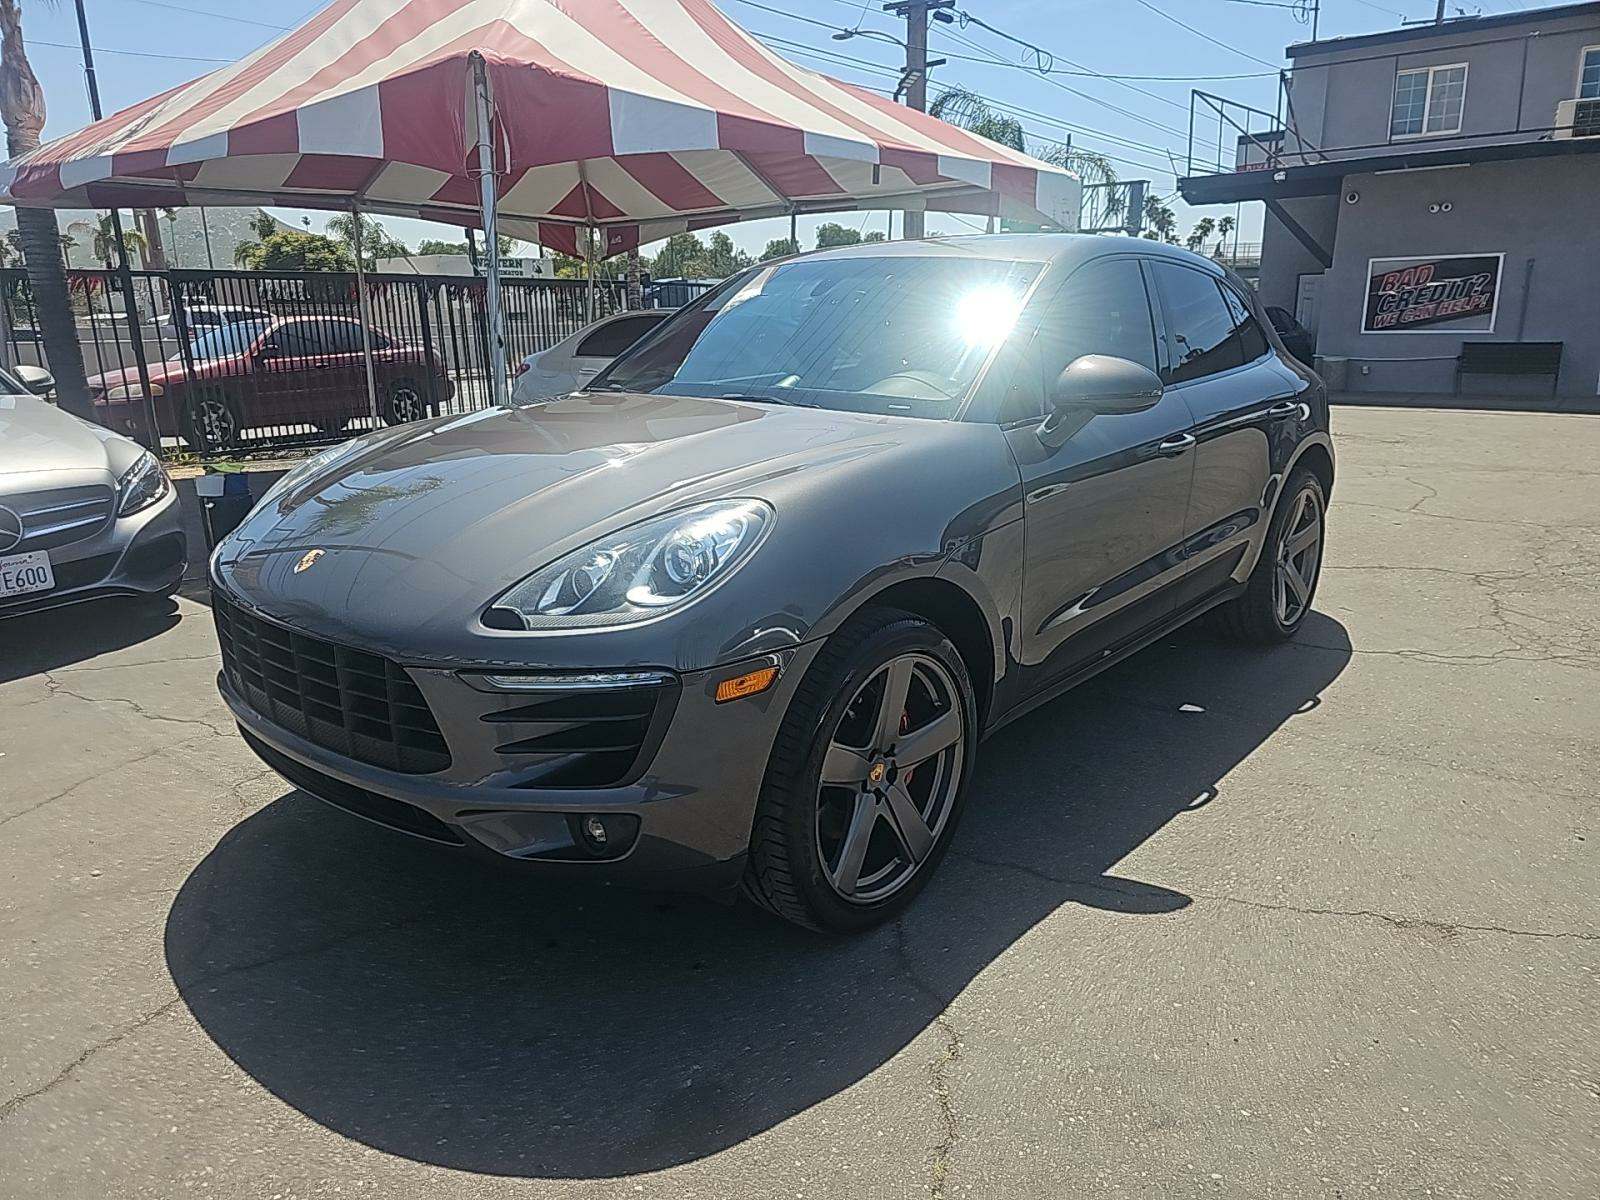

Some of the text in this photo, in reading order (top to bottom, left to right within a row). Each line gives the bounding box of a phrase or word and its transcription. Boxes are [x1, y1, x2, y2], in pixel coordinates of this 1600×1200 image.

[1377, 273, 1491, 315] CREDIT?
[1379, 265, 1434, 294] BAD
[1373, 293, 1490, 328] WE CAN HELP!
[0, 566, 48, 590] E600
